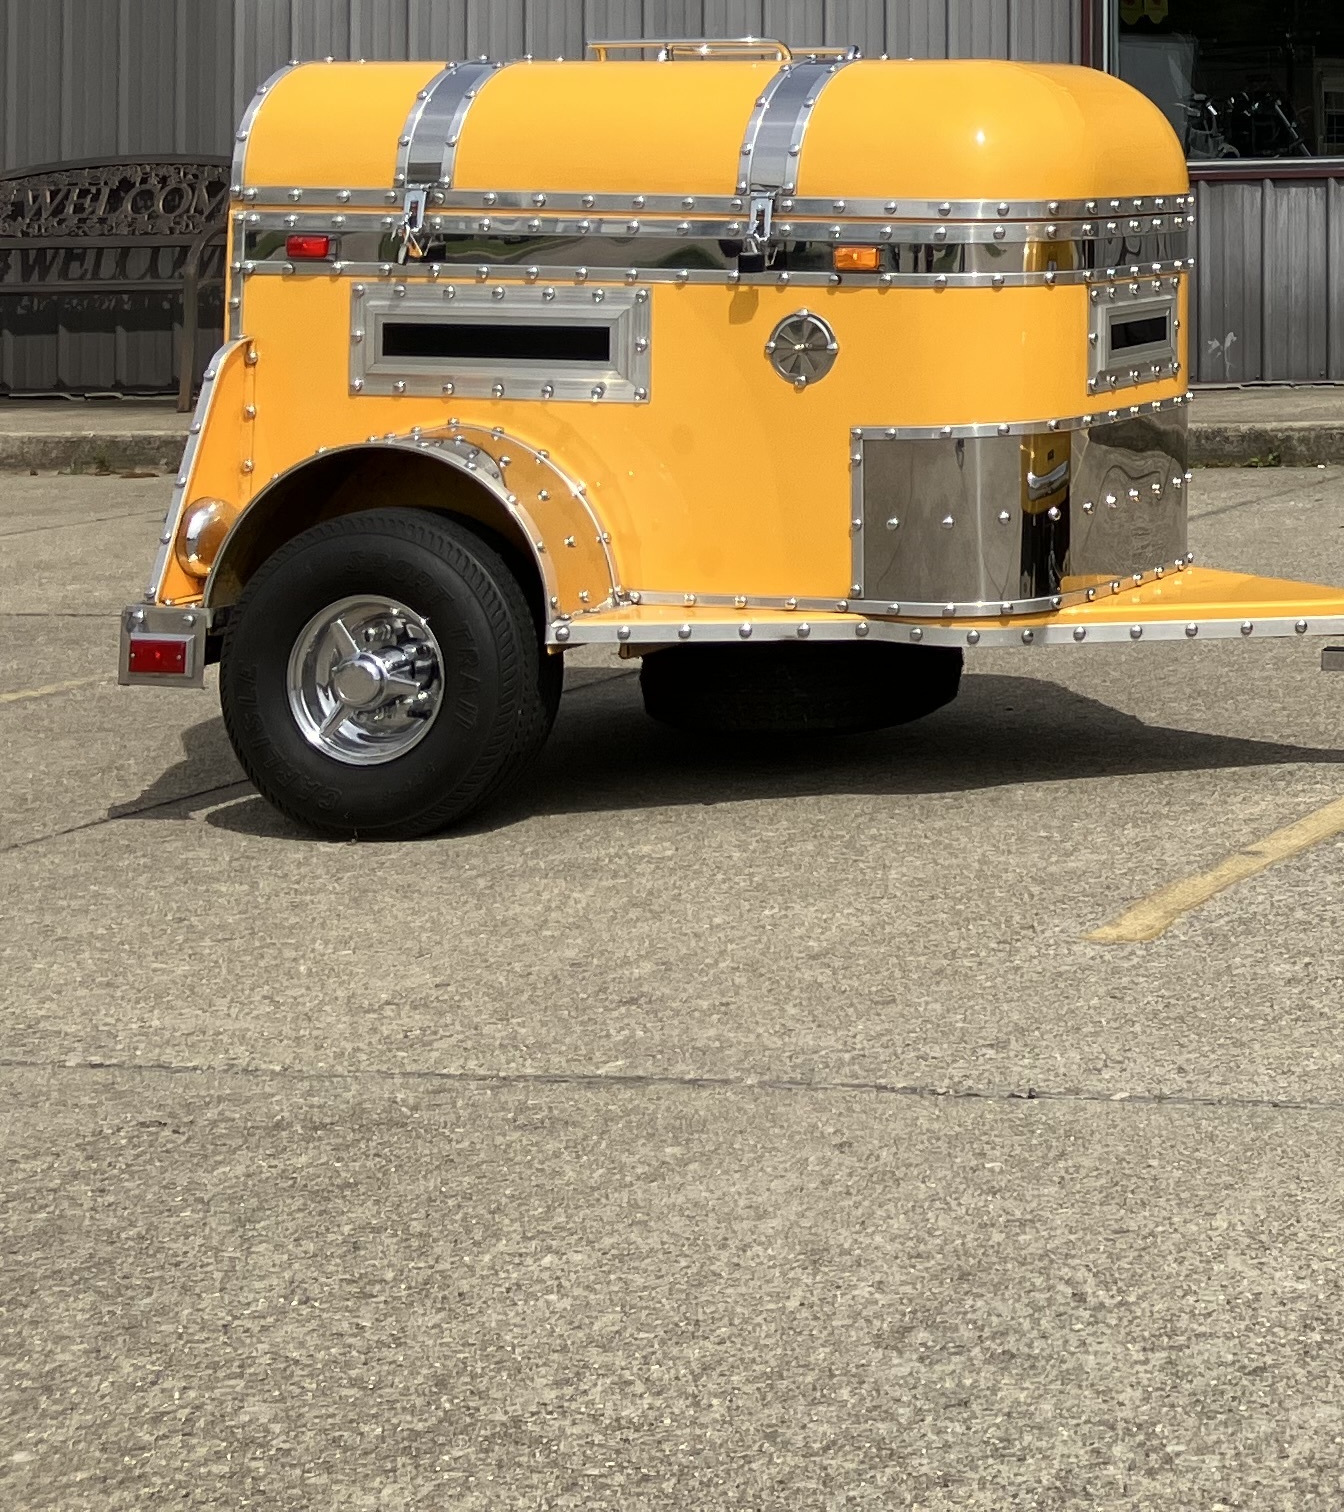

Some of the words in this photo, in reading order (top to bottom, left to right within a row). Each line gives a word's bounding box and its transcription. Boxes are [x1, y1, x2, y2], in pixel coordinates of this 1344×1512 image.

[24, 184, 231, 222] WELCOM
[345, 552, 454, 606] SPORT
[237, 661, 343, 811] CARLISLE
